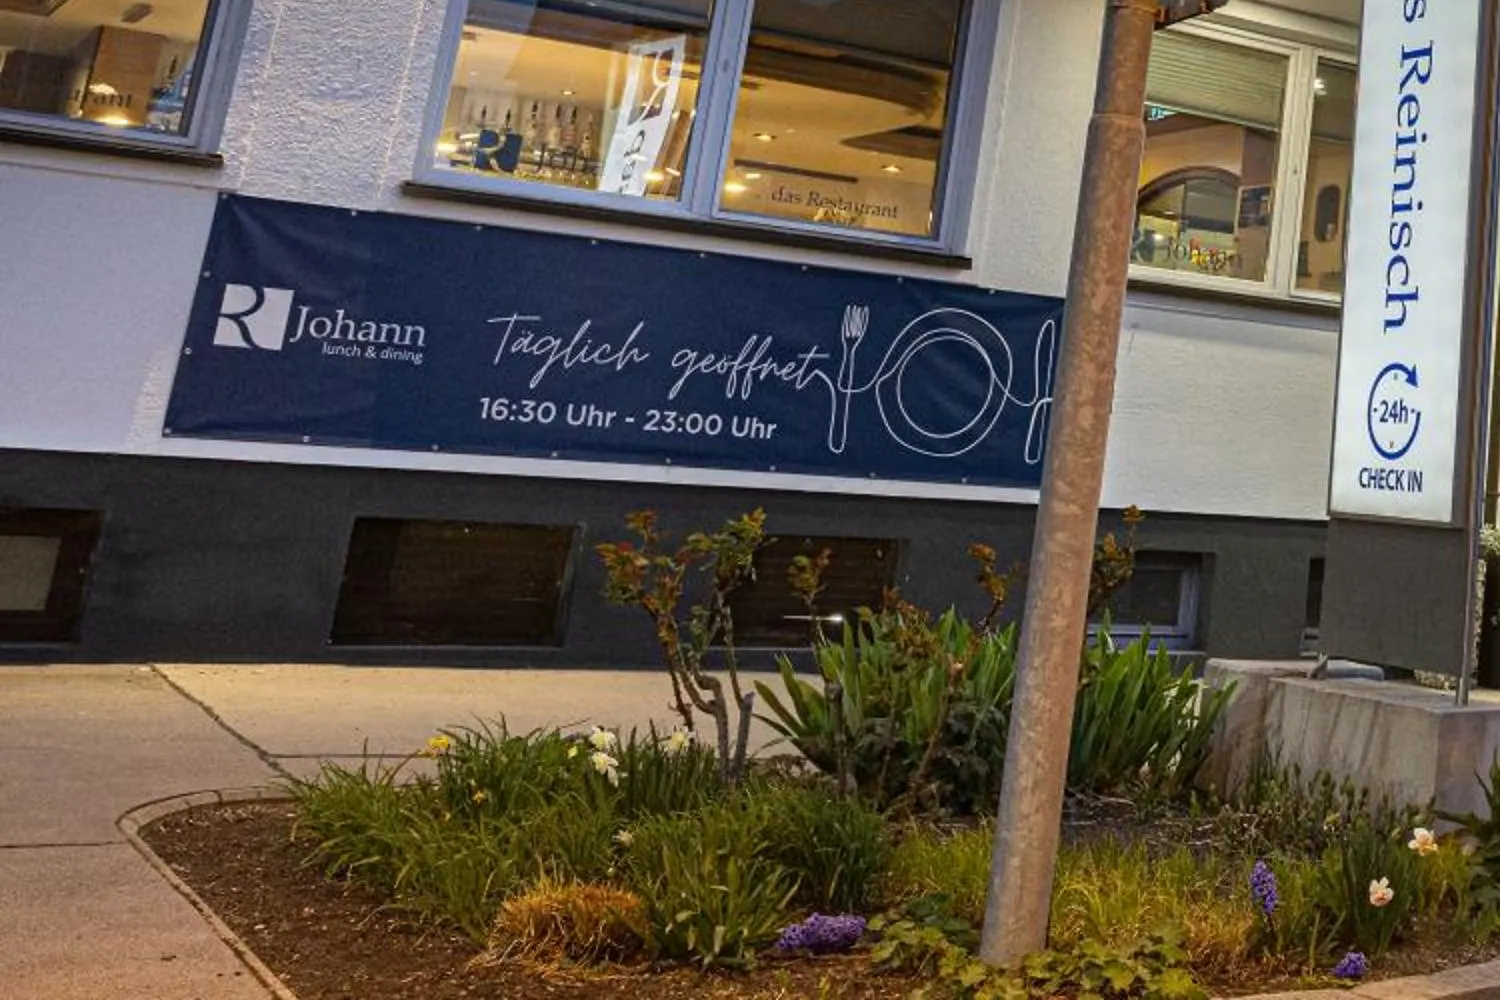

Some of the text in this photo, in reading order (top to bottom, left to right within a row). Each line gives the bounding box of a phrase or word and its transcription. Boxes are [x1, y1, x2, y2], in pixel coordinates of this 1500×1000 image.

[771, 185, 899, 219] das Restaurant
[1382, 38, 1435, 335] Reinisch
[289, 304, 426, 347] Johann
[321, 341, 424, 365] lunch & dining
[486, 312, 651, 390] Täglich
[479, 397, 557, 424] 16:30
[566, 403, 617, 428] Uhr
[642, 409, 723, 436] 23:00
[731, 416, 778, 440] Uhr
[1379, 400, 1409, 424] 24h
[1358, 467, 1424, 493] CHECK IN
